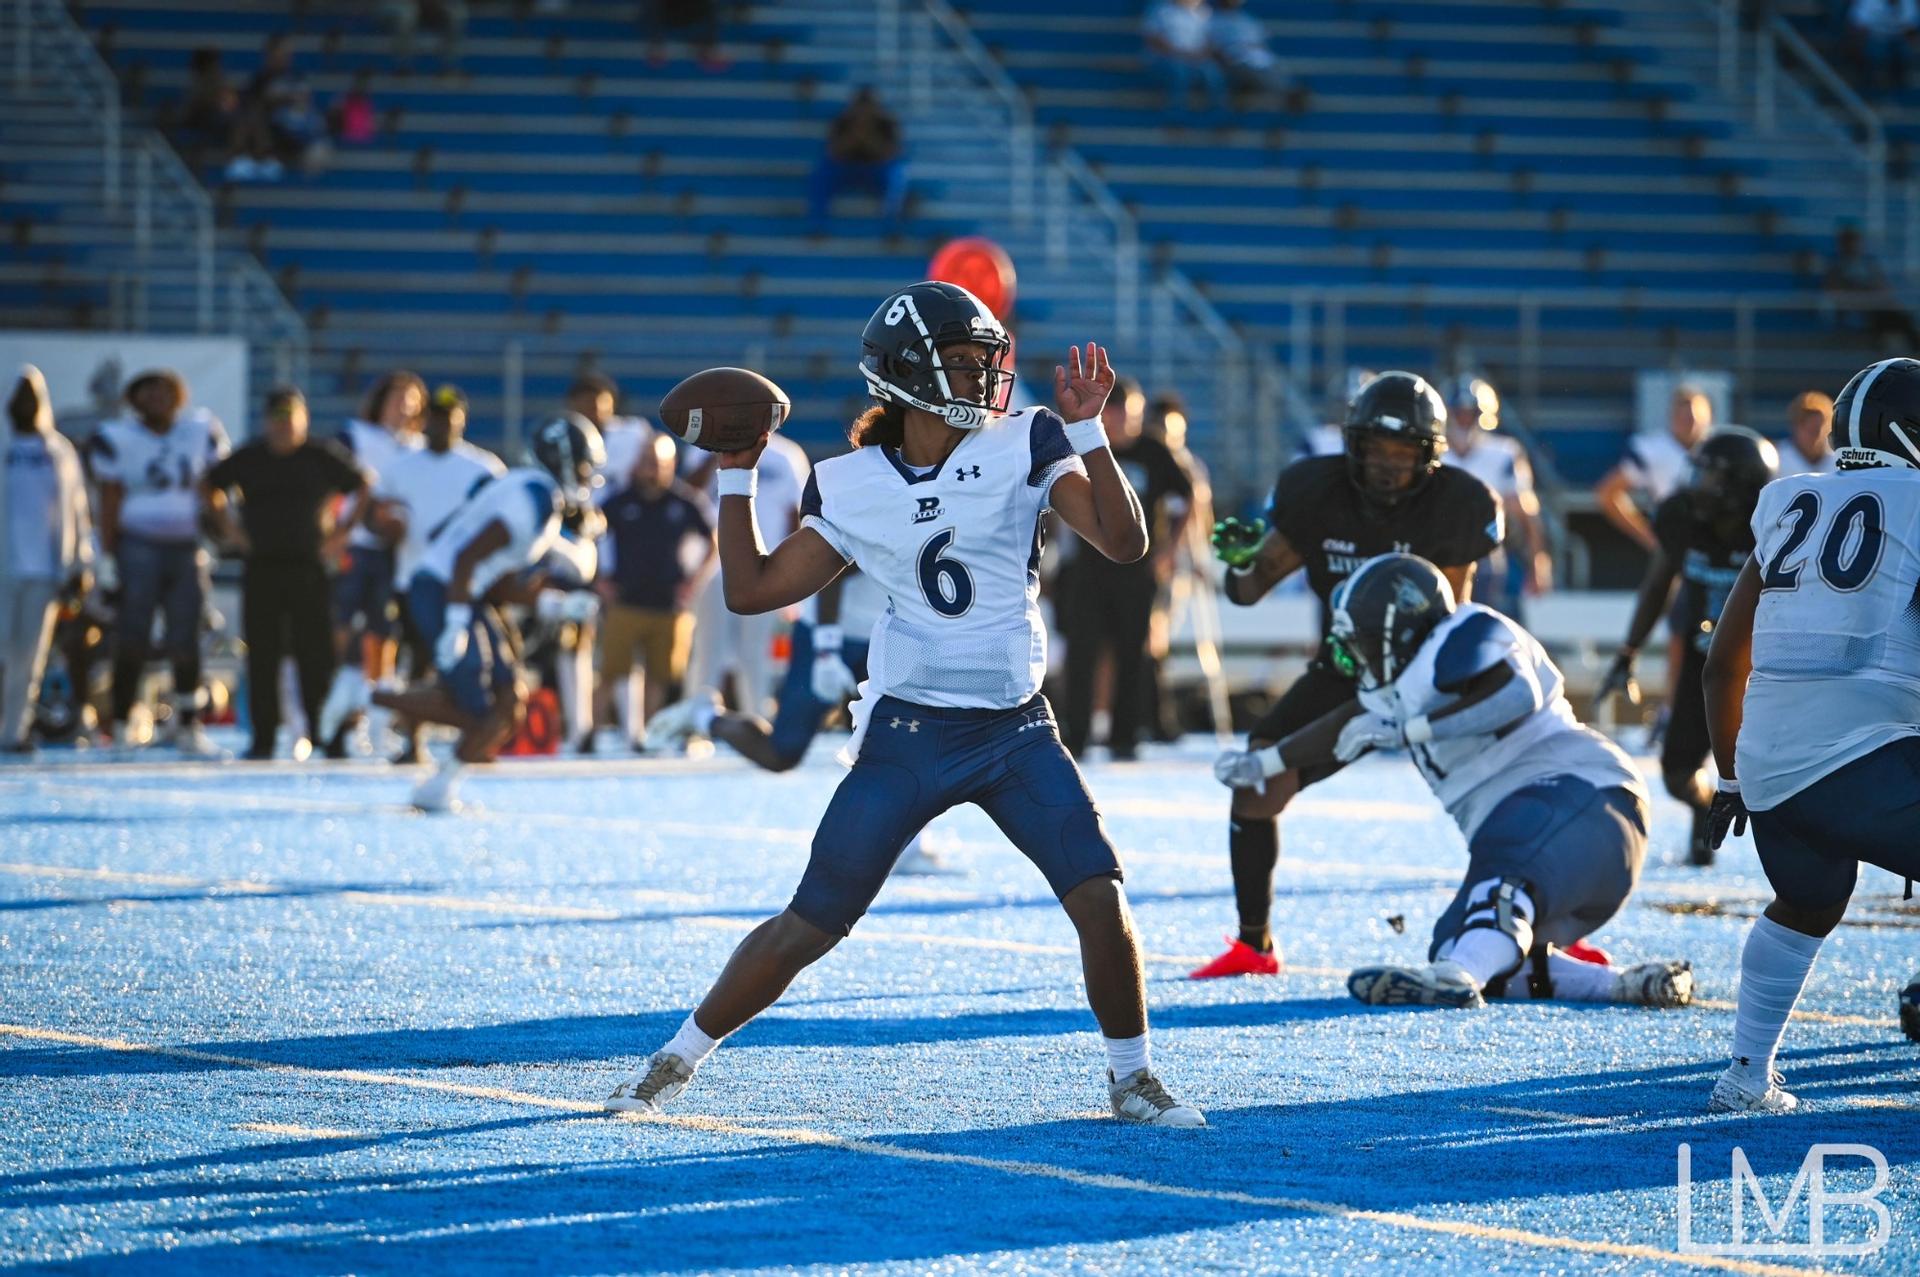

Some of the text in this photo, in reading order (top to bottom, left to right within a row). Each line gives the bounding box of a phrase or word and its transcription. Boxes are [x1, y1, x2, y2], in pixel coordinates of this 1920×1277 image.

[884, 294, 914, 326] 6
[910, 398, 932, 410] ADAMS
[1841, 448, 1877, 461] schutt
[913, 508, 944, 520] STATE
[1760, 489, 1887, 594] 20
[915, 525, 977, 620] 6
